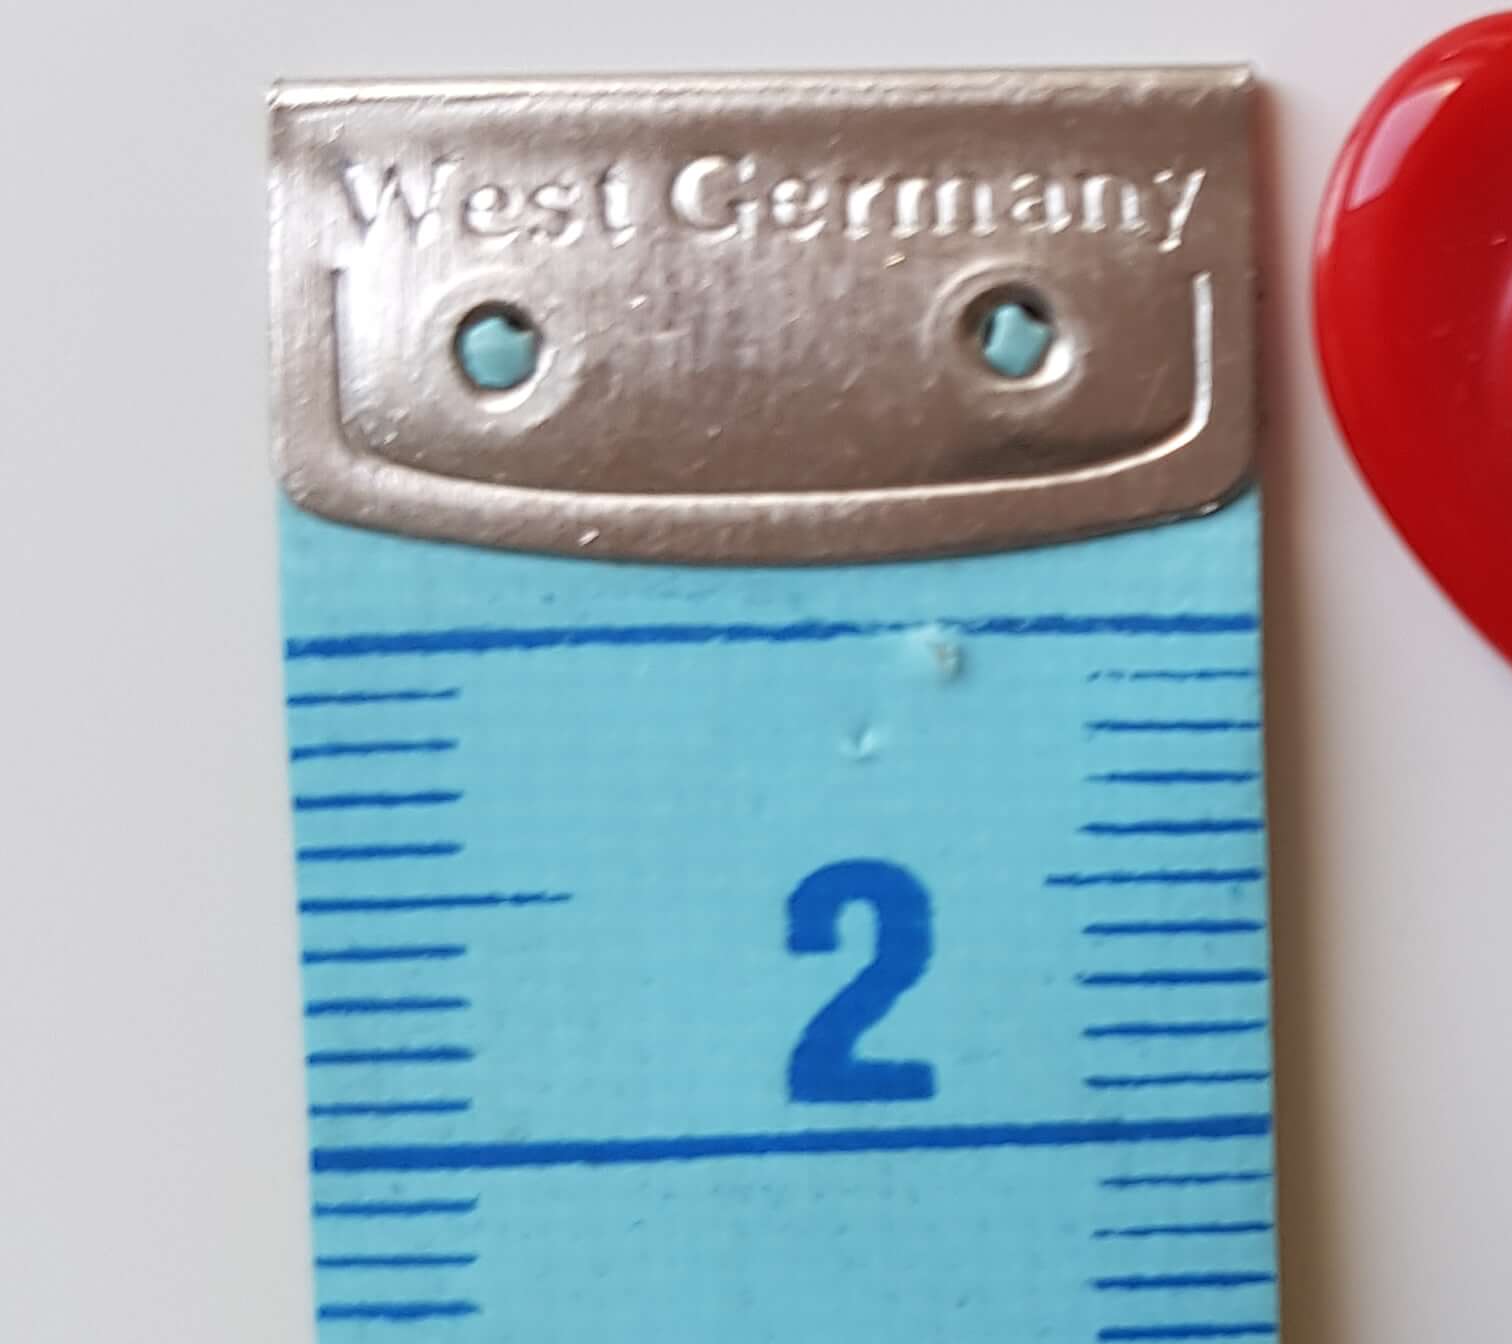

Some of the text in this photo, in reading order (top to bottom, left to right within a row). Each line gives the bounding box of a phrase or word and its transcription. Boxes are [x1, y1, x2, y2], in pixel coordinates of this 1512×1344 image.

[338, 152, 1208, 255] West Germany
[783, 857, 939, 1105] 2
